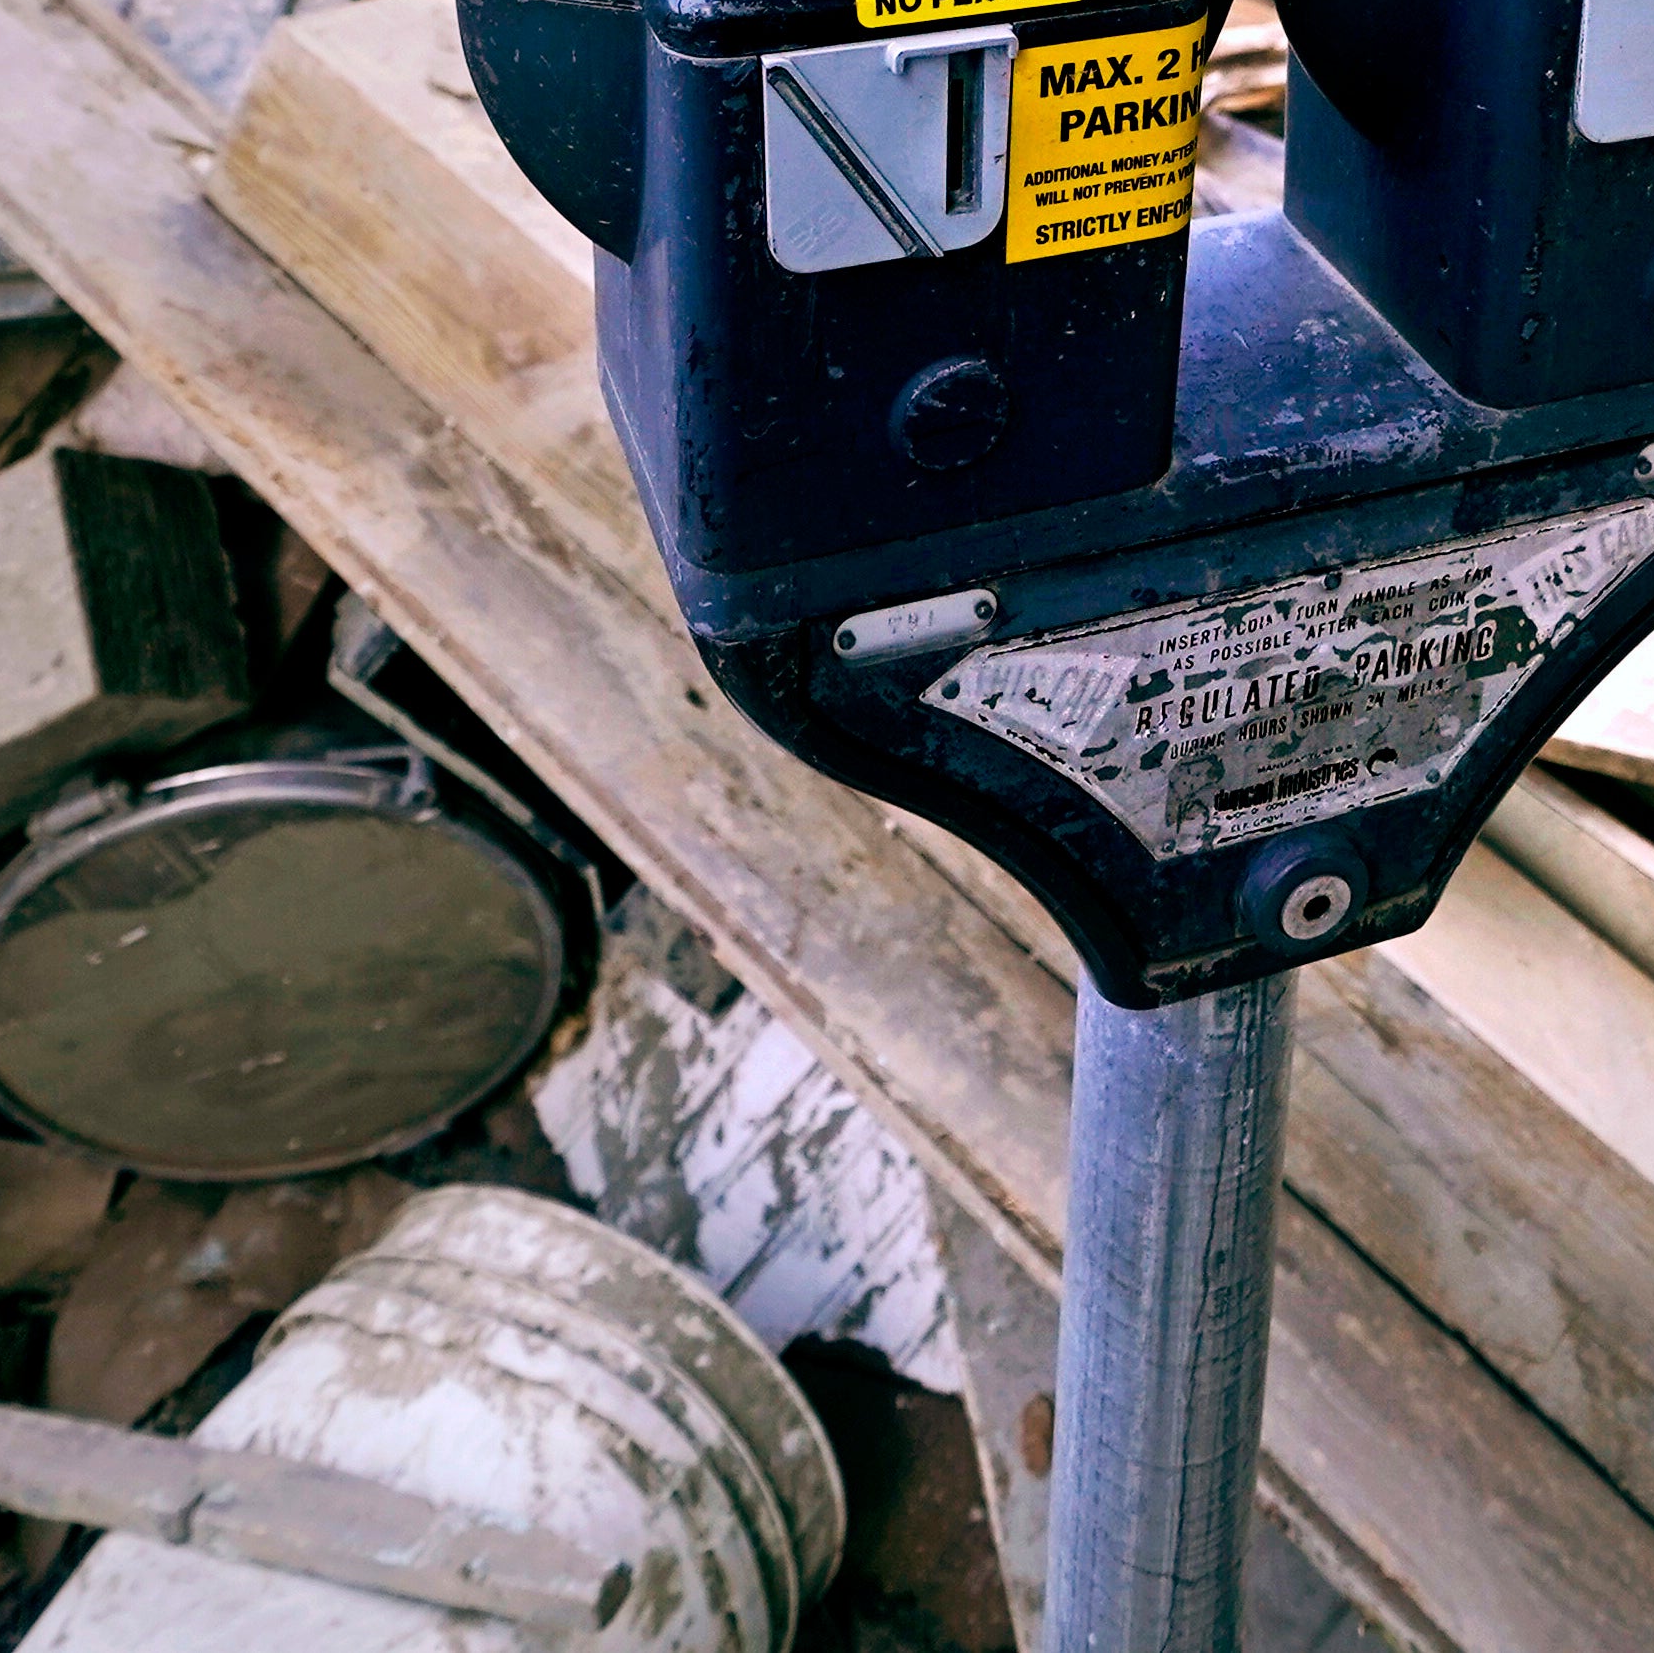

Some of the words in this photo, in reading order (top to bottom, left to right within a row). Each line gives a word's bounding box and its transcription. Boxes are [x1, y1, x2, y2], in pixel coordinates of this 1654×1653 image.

[1040, 54, 1143, 98] MAX.
[1156, 48, 1180, 81] 2
[1024, 162, 1107, 187] ADDITIONAL
[1111, 152, 1160, 173] MONEY
[1035, 190, 1069, 207] WILL
[1073, 183, 1101, 201] NOT
[1104, 171, 1164, 196] PREVENT
[1166, 171, 1176, 185] A
[1035, 210, 1131, 245] STRICTLY
[1159, 626, 1222, 655] INSERT
[1296, 599, 1338, 621] TURN
[1352, 581, 1417, 608] HANDLE
[1429, 574, 1450, 592] AS
[1464, 565, 1493, 584] FAR
[1173, 655, 1195, 671] AS
[1210, 631, 1292, 664] POSSIBLE
[1305, 615, 1359, 641] AFTER
[1372, 603, 1414, 625] EACH
[1135, 665, 1321, 736] REGULATED
[1353, 626, 1494, 686] PARKING
[1170, 731, 1226, 760] DURING
[1238, 716, 1287, 742] HOURS
[1300, 701, 1353, 729] SHOWN
